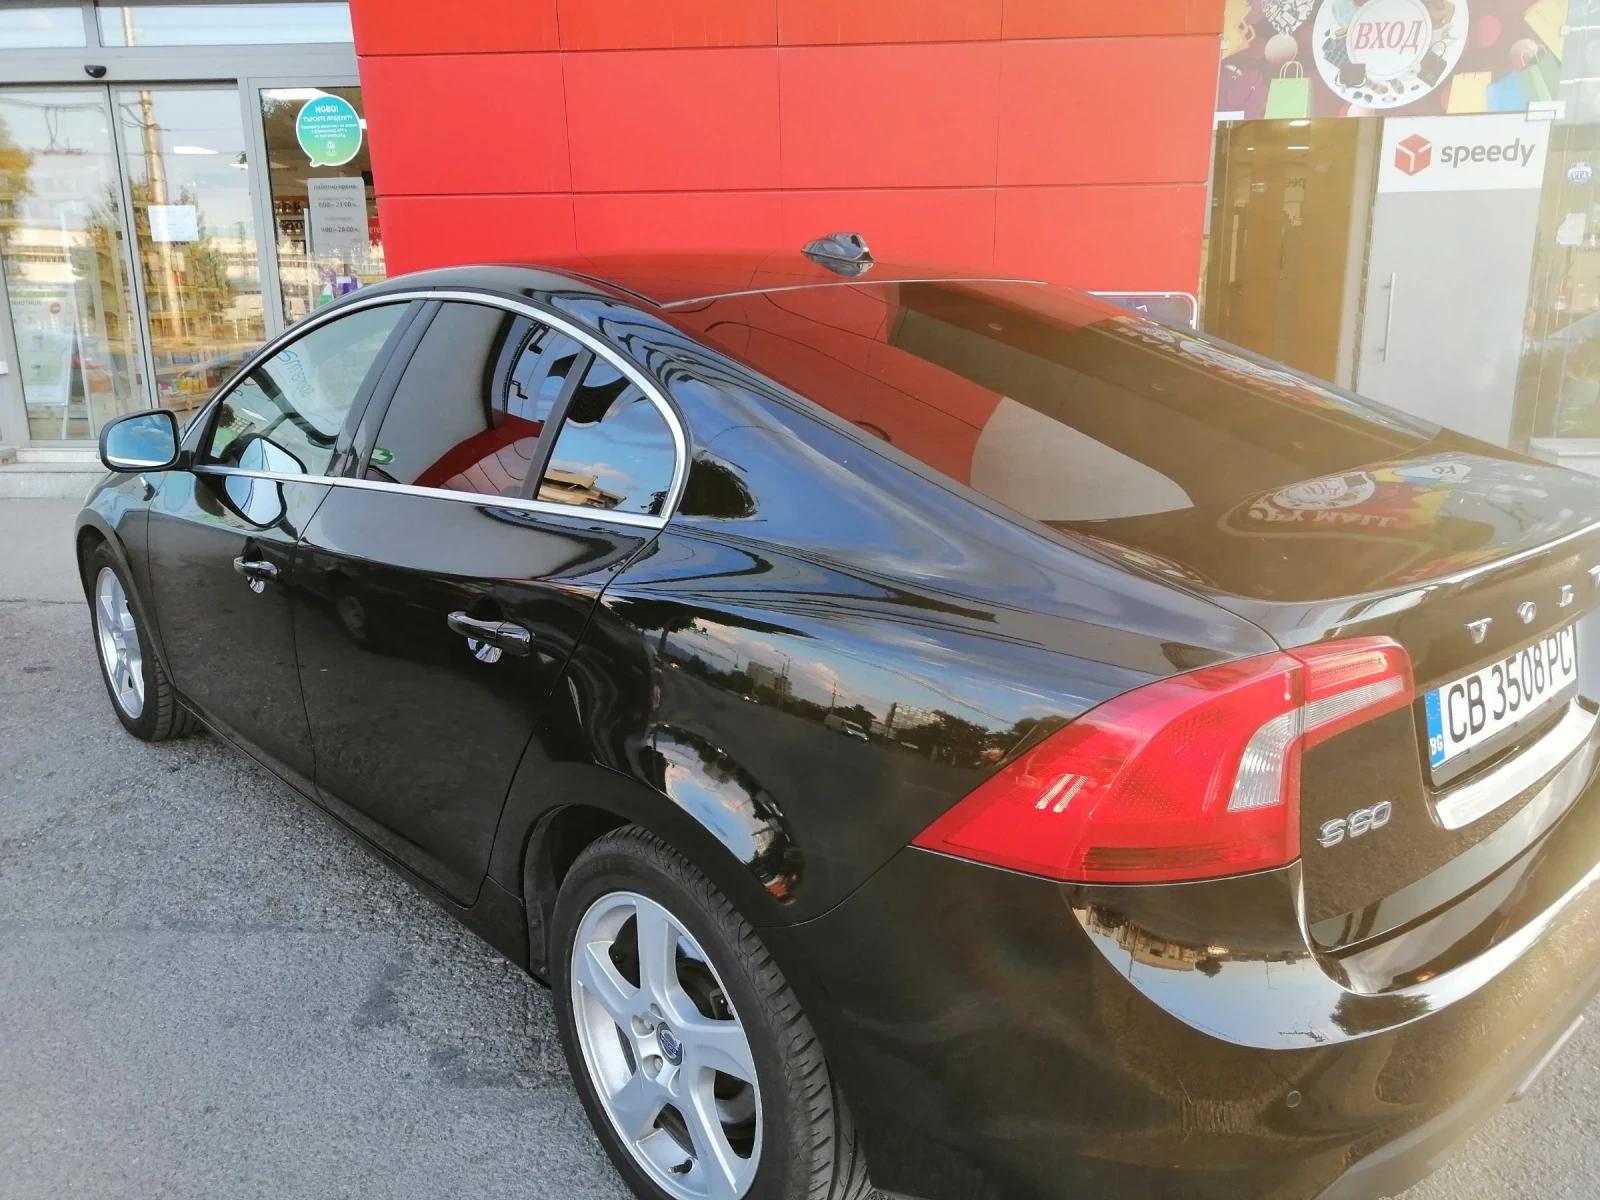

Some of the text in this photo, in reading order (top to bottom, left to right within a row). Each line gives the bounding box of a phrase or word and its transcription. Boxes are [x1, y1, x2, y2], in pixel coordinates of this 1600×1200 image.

[1353, 20, 1424, 55] ВХОД
[315, 105, 338, 113] НОВО!
[1440, 138, 1536, 168] speedy
[1447, 628, 1573, 743] CB 3508 PC
[1429, 735, 1444, 756] BG
[1317, 801, 1392, 848] S60
